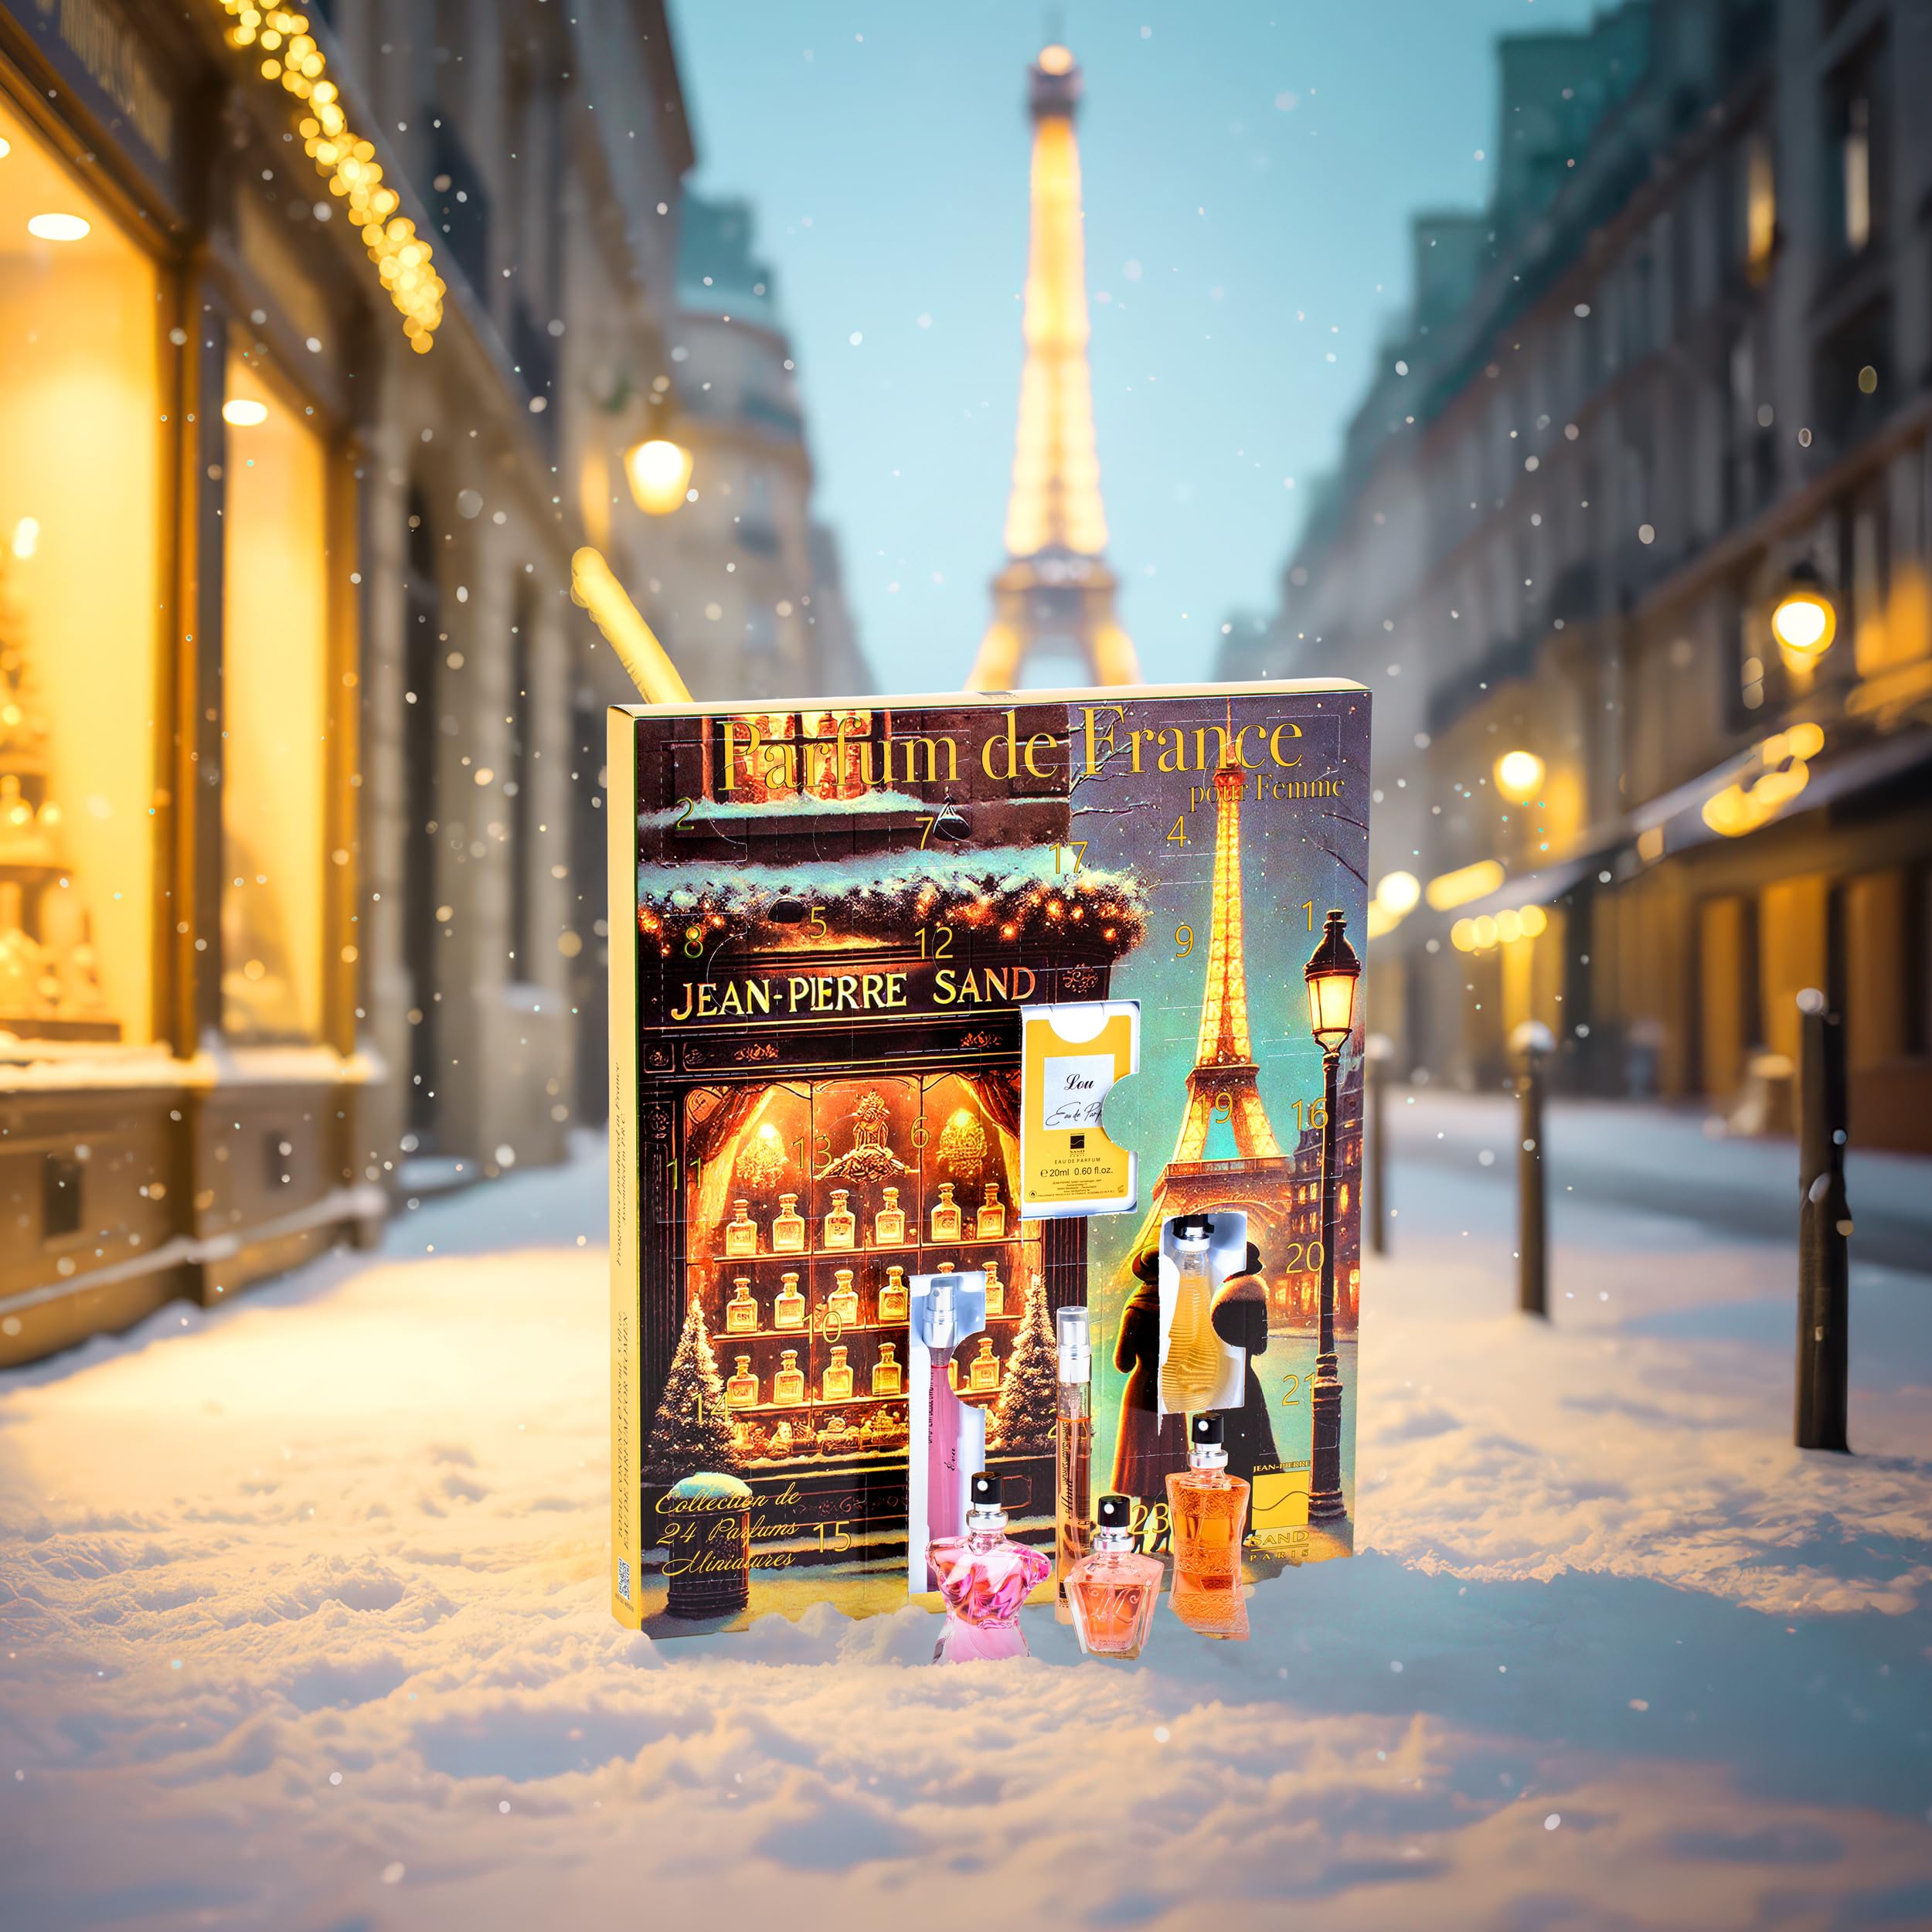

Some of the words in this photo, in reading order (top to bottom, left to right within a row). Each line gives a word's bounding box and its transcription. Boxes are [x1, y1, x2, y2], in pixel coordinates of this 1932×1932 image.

[716, 715, 961, 792] Parfum
[981, 709, 1058, 781] de
[1078, 704, 1304, 776] France
[1188, 783, 1249, 813] pour
[1255, 773, 1345, 801] Femme
[675, 796, 695, 832] 2
[914, 816, 934, 851] 7
[1166, 815, 1188, 849] 4
[1049, 840, 1089, 875] 17
[809, 906, 827, 940] 5
[1301, 900, 1314, 932] 1
[684, 924, 704, 959] 8
[914, 926, 954, 961] 12
[1174, 923, 1195, 957] 9
[671, 971, 907, 1021] JEAN-PIERRE
[932, 966, 1036, 1005] SAND
[1064, 1073, 1094, 1090] Lou
[1045, 1101, 1081, 1126] Eau
[1072, 1108, 1081, 1122] de
[1084, 1101, 1103, 1123] Parf
[1196, 1091, 1233, 1125] 19
[1291, 1097, 1329, 1131] 16
[910, 1115, 930, 1149] 6
[792, 1135, 833, 1169] 13
[665, 1156, 702, 1192] 11
[1049, 1168, 1070, 1177] 20ml
[1073, 1167, 1092, 1175] 0.60
[1094, 1166, 1114, 1175] fl.oz.
[1285, 1240, 1325, 1274] 20
[801, 1310, 842, 1345] 10
[1281, 1372, 1315, 1406] 21
[691, 1390, 733, 1423] 14
[1252, 1460, 1311, 1473] JEAN-PIERRE
[623, 1488, 629, 1512] DE
[655, 1488, 770, 1515] Collection
[774, 1481, 803, 1505] de
[655, 1521, 697, 1546] 24
[708, 1514, 801, 1549] Parfums
[1130, 1502, 1169, 1536] 23
[812, 1520, 852, 1553] 15
[1250, 1529, 1310, 1546] SAND
[661, 1549, 796, 1577] Miniatures
[1250, 1549, 1310, 1562] PARIS
